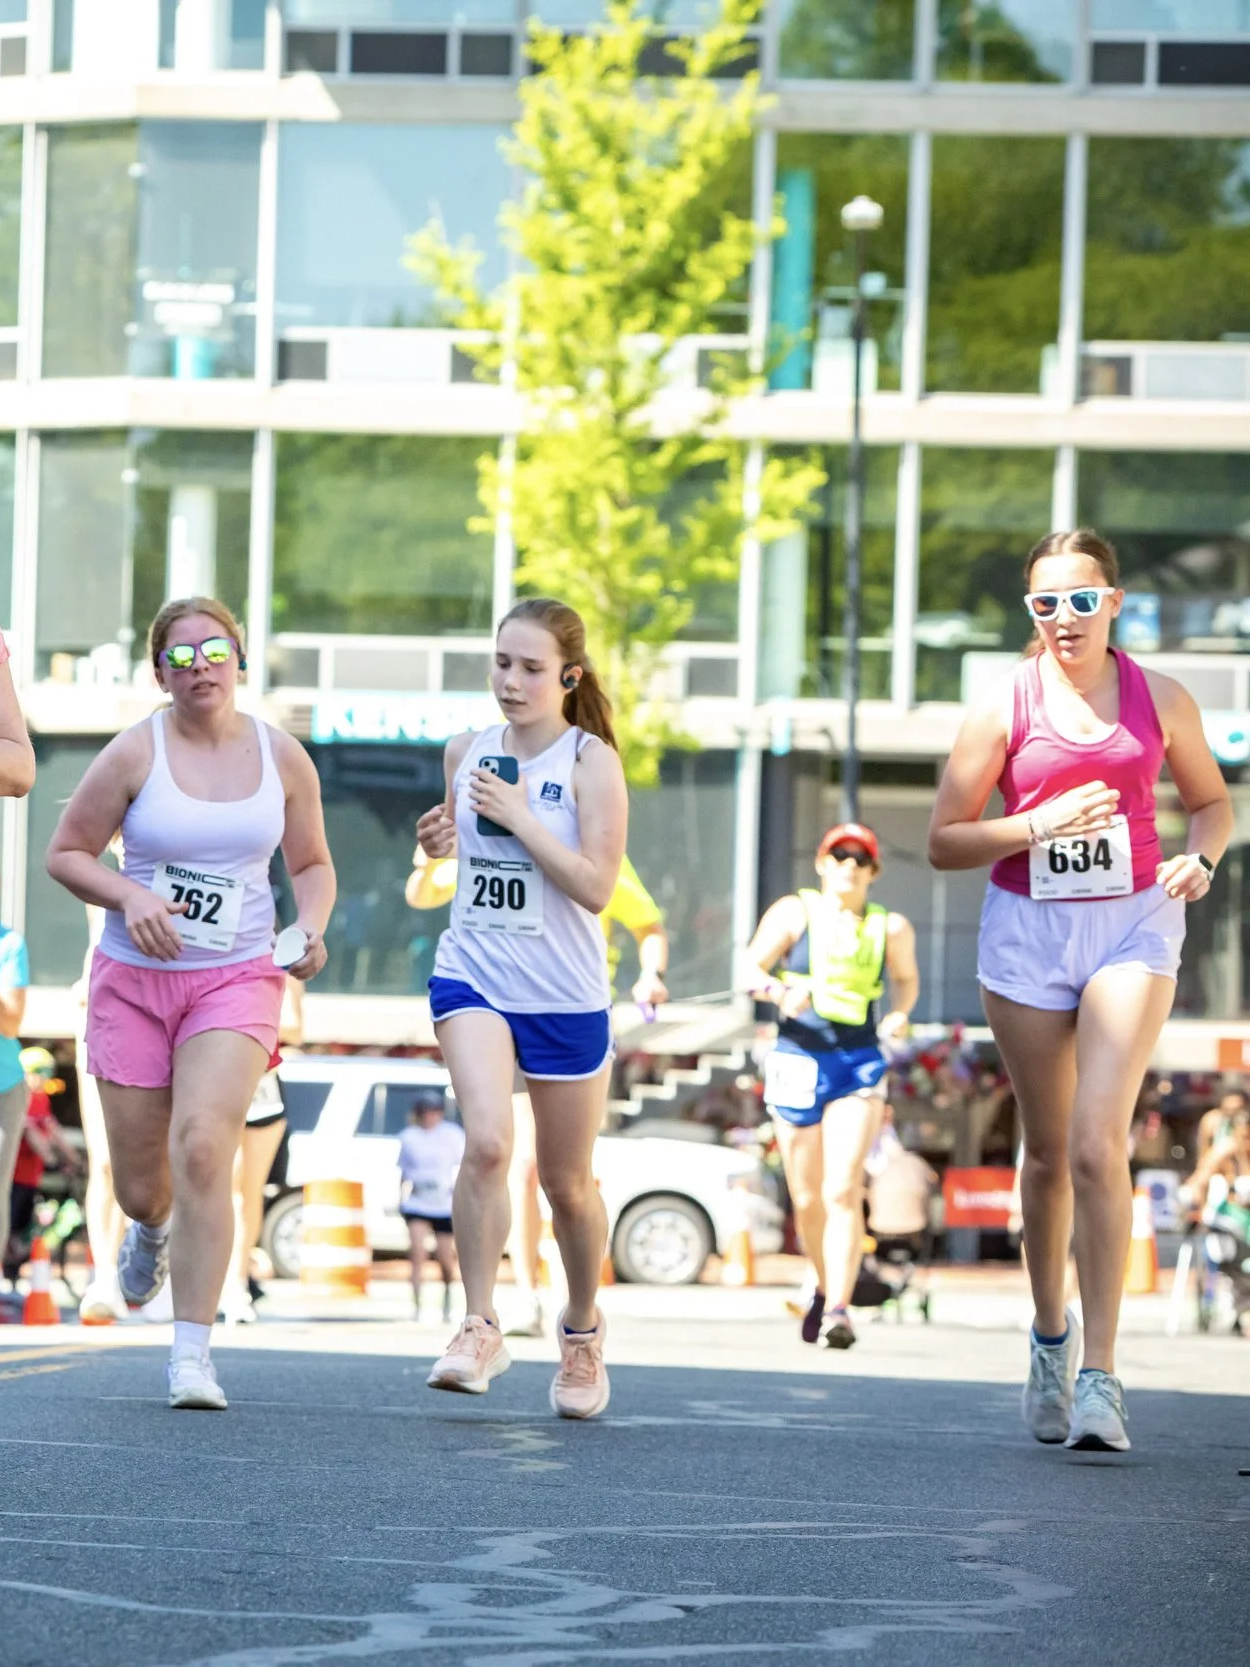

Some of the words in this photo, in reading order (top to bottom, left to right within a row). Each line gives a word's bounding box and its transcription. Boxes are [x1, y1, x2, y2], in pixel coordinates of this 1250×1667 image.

[470, 857, 521, 871] BIONIC
[1048, 838, 1113, 874] 634
[165, 865, 226, 887] BIONIC
[472, 874, 526, 910] 290
[171, 883, 223, 925] 762
